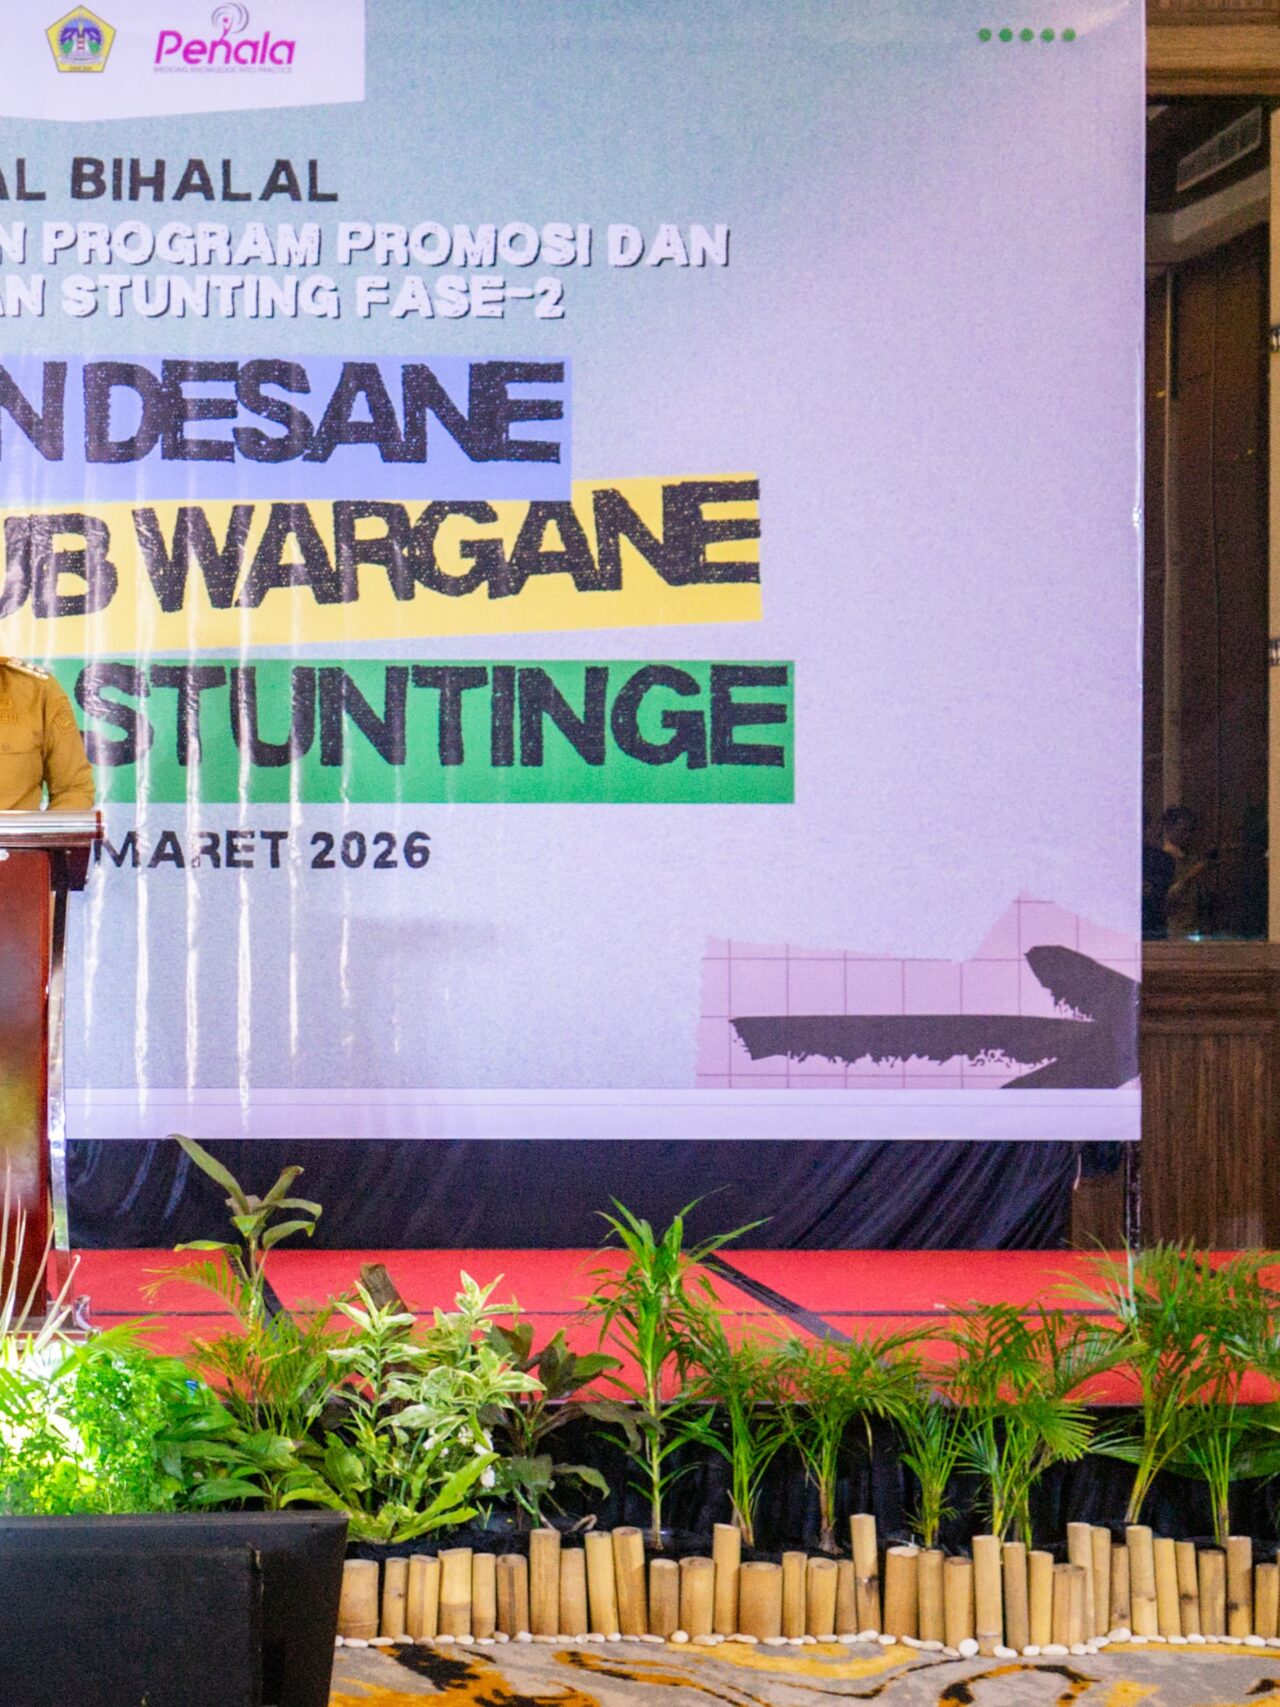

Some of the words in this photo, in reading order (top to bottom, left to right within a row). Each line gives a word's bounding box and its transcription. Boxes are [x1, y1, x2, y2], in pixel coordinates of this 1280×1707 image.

[71, 157, 338, 202] BIHALAL
[43, 221, 320, 266] PROGRAM
[337, 222, 592, 267] PROMOSI
[608, 223, 730, 267] DAN
[61, 274, 341, 318] STUNTING
[356, 275, 565, 319] FASE-2
[83, 358, 565, 465] DESANE
[133, 480, 761, 613] WARGANE
[74, 662, 789, 770] STUNTINGE
[94, 830, 289, 869] MARET
[311, 830, 430, 870] 2026
